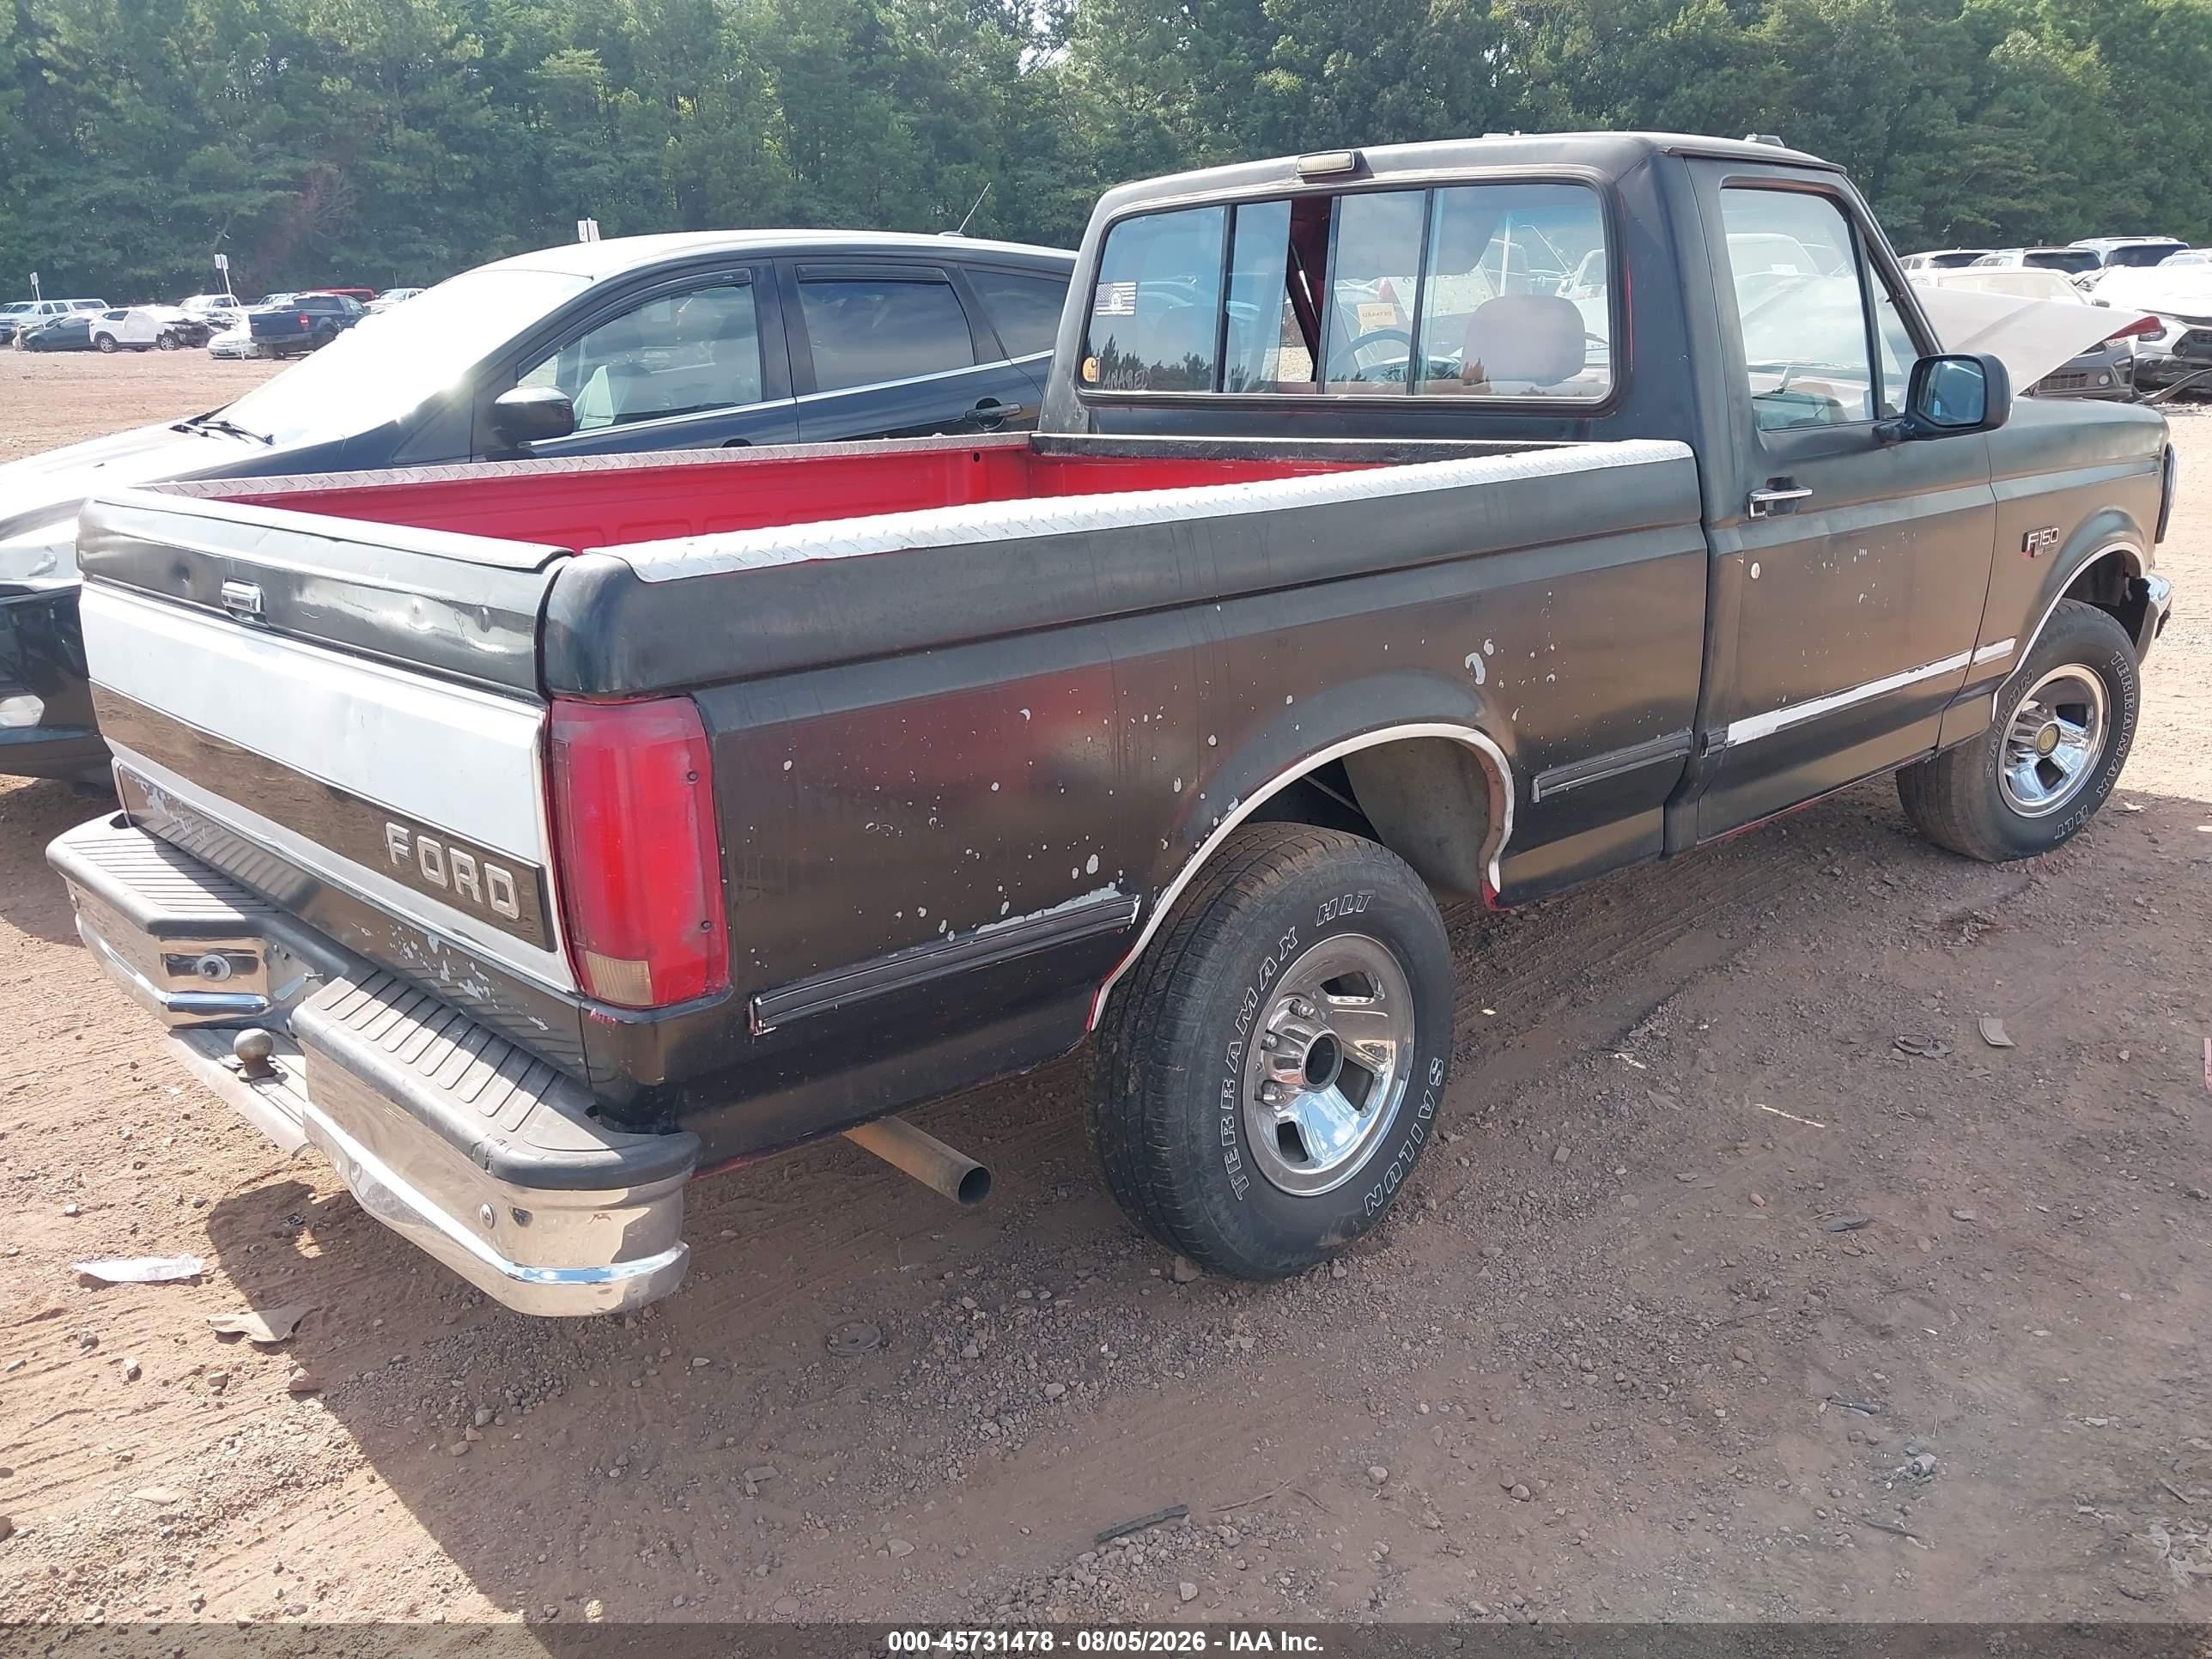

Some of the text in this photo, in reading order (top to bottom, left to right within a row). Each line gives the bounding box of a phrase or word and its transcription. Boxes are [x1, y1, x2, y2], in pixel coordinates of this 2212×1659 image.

[2054, 650, 2135, 841] TERRAMAX HLT
[386, 821, 520, 921] FORD
[1220, 893, 1374, 1201] TERRAMAX HLT
[1364, 1057, 1444, 1217] SAILUN
